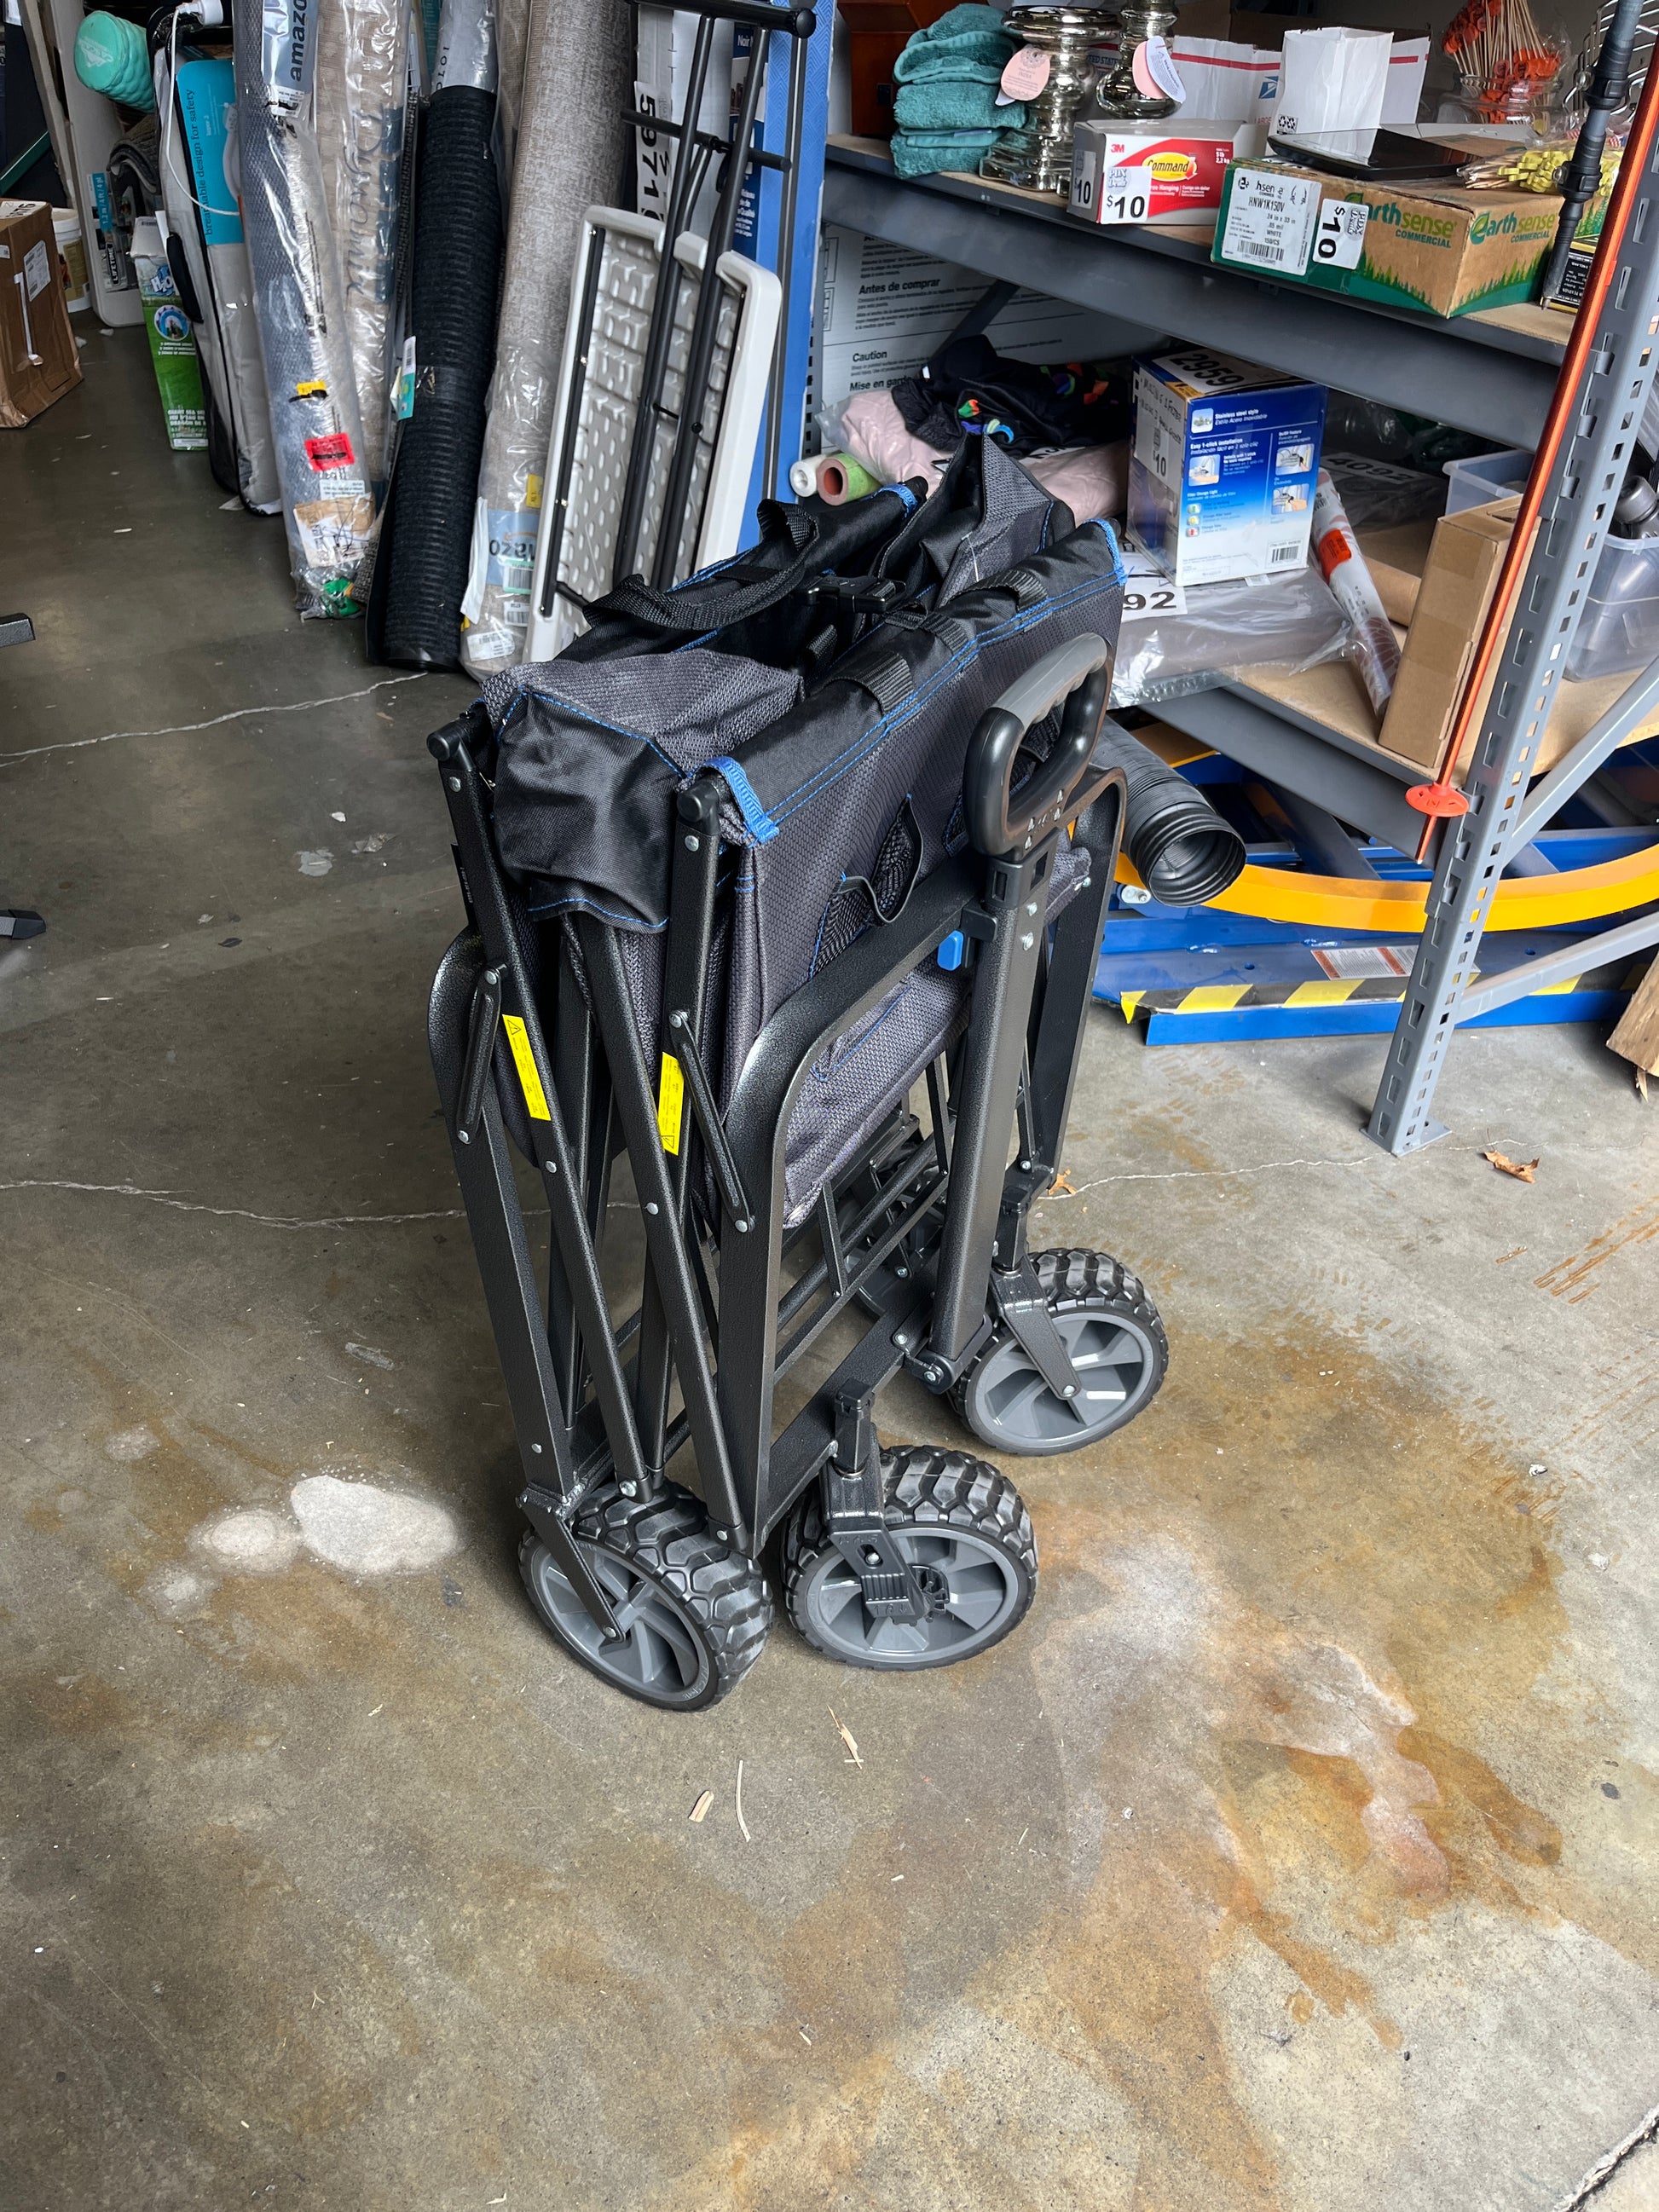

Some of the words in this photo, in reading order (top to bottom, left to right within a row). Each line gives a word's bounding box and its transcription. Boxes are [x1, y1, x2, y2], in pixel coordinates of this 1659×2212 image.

[291, 0, 308, 82] amazo
[186, 89, 197, 123] safety
[191, 124, 199, 141] for
[1111, 144, 1124, 153] 3M
[194, 142, 205, 178] design
[1147, 159, 1189, 173] Command
[1107, 194, 1145, 219] $10
[1266, 229, 1282, 238] WHITE
[1318, 206, 1345, 258] $10
[1357, 211, 1366, 235] PDX
[1395, 228, 1452, 249] COMMERCIAL
[1510, 230, 1550, 244] COMMERCIAL
[107, 246, 118, 281] LIFETIME
[858, 284, 886, 295] Antes
[888, 281, 899, 292] de
[902, 278, 940, 291] comprar
[853, 350, 887, 362] Caution
[1169, 354, 1245, 386] 2959
[850, 381, 870, 391] Mise
[873, 378, 884, 389] en
[1326, 458, 1415, 480] 4092
